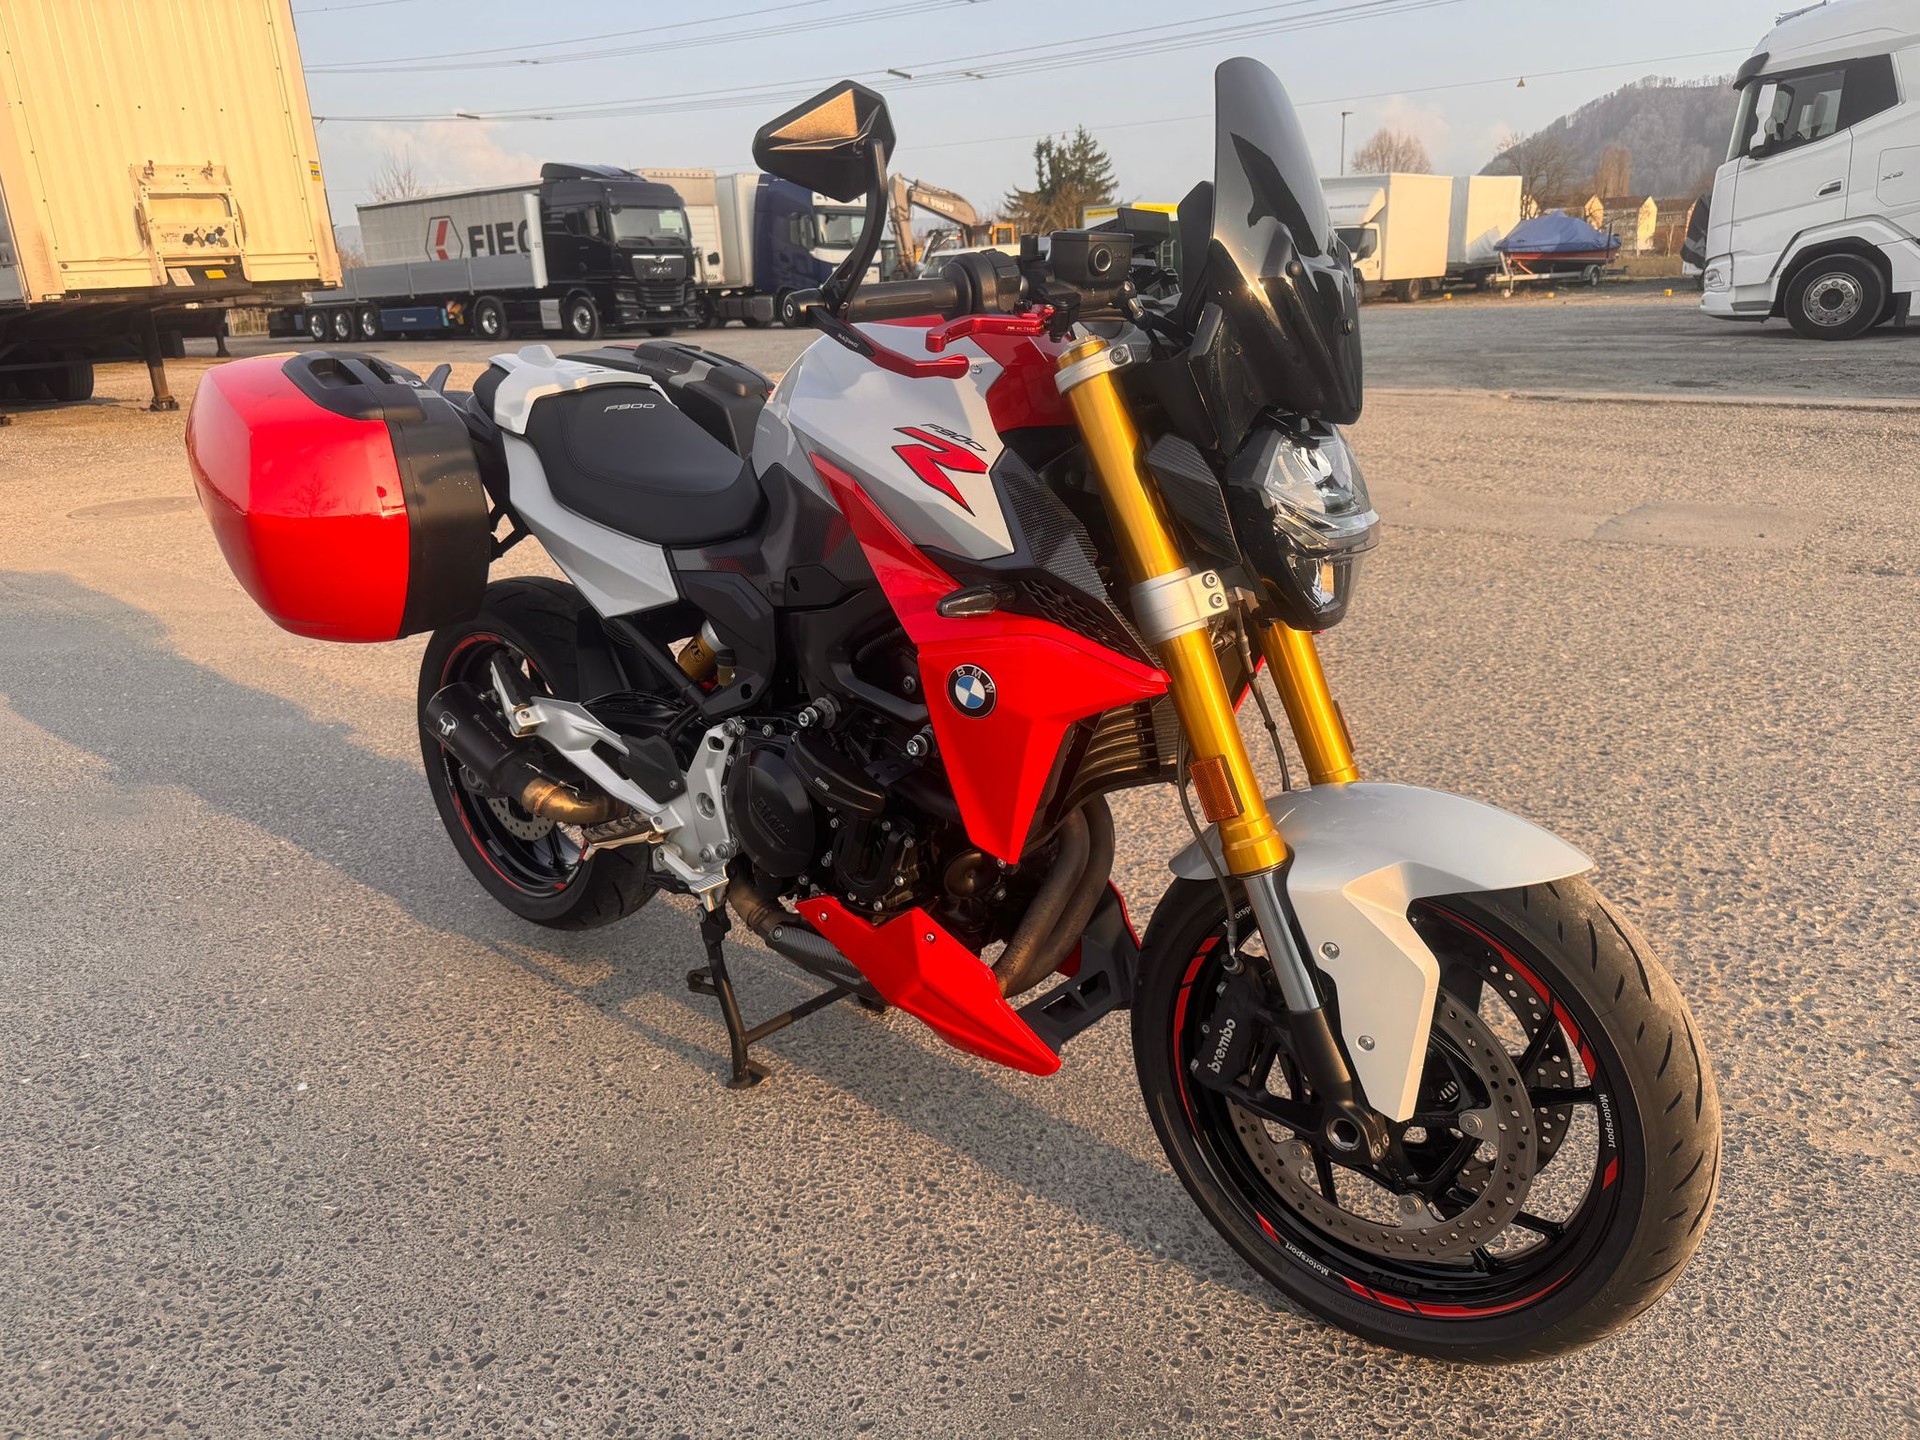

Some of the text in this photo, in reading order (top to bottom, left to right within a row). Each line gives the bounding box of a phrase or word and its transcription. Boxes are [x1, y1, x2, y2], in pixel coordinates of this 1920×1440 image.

[604, 403, 656, 413] F900
[920, 423, 988, 452] F900
[956, 666, 994, 693] BMW
[1207, 1018, 1237, 1074] brembo
[1598, 1093, 1616, 1148] Motorsport
[1284, 1242, 1330, 1277] Motorsport
